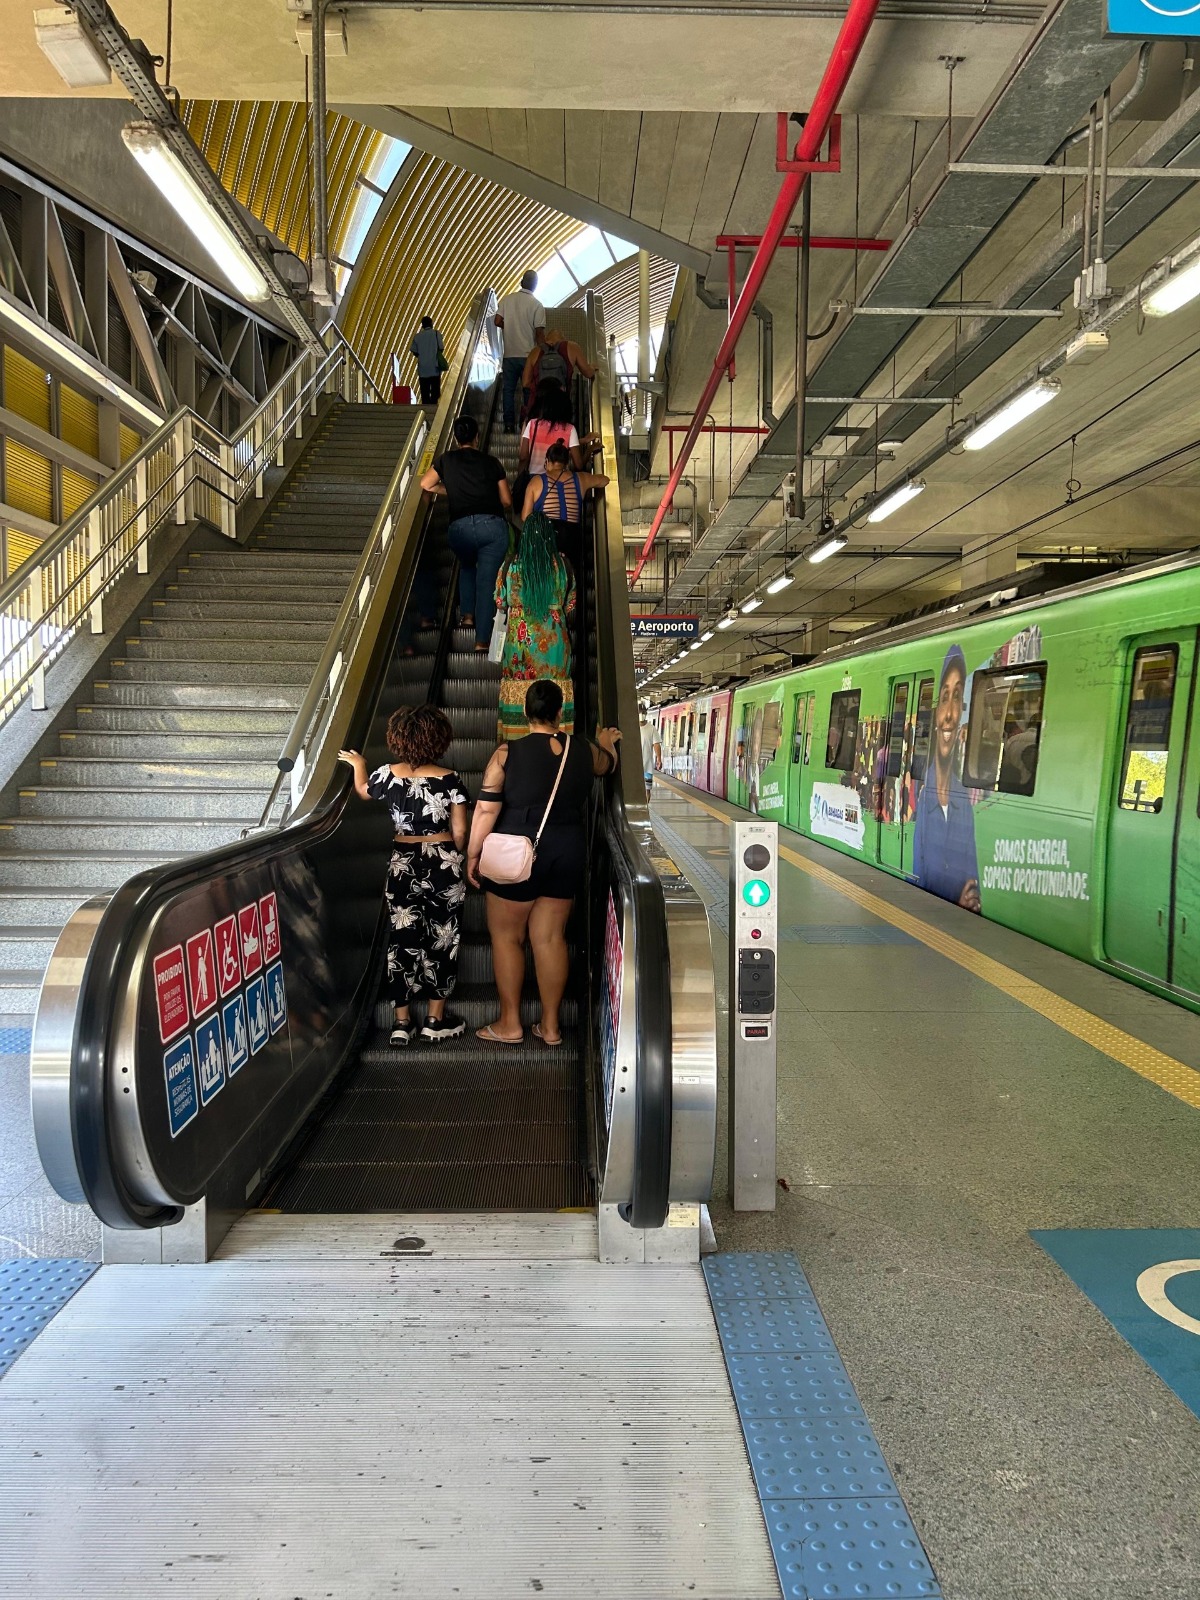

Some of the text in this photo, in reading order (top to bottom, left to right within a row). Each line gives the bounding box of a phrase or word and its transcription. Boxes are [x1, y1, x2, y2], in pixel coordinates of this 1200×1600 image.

[638, 620, 694, 634] Aeroporto
[994, 838, 1070, 869] SOMOS ENERGIA,
[982, 866, 1090, 900] SOMOS OPORTUNIDADE.
[158, 962, 182, 986] PROIBIDO
[164, 1004, 184, 1024] ELEVADORES
[168, 1052, 190, 1082] ATENÇÃO
[174, 1095, 192, 1117] SEGURANÇA
